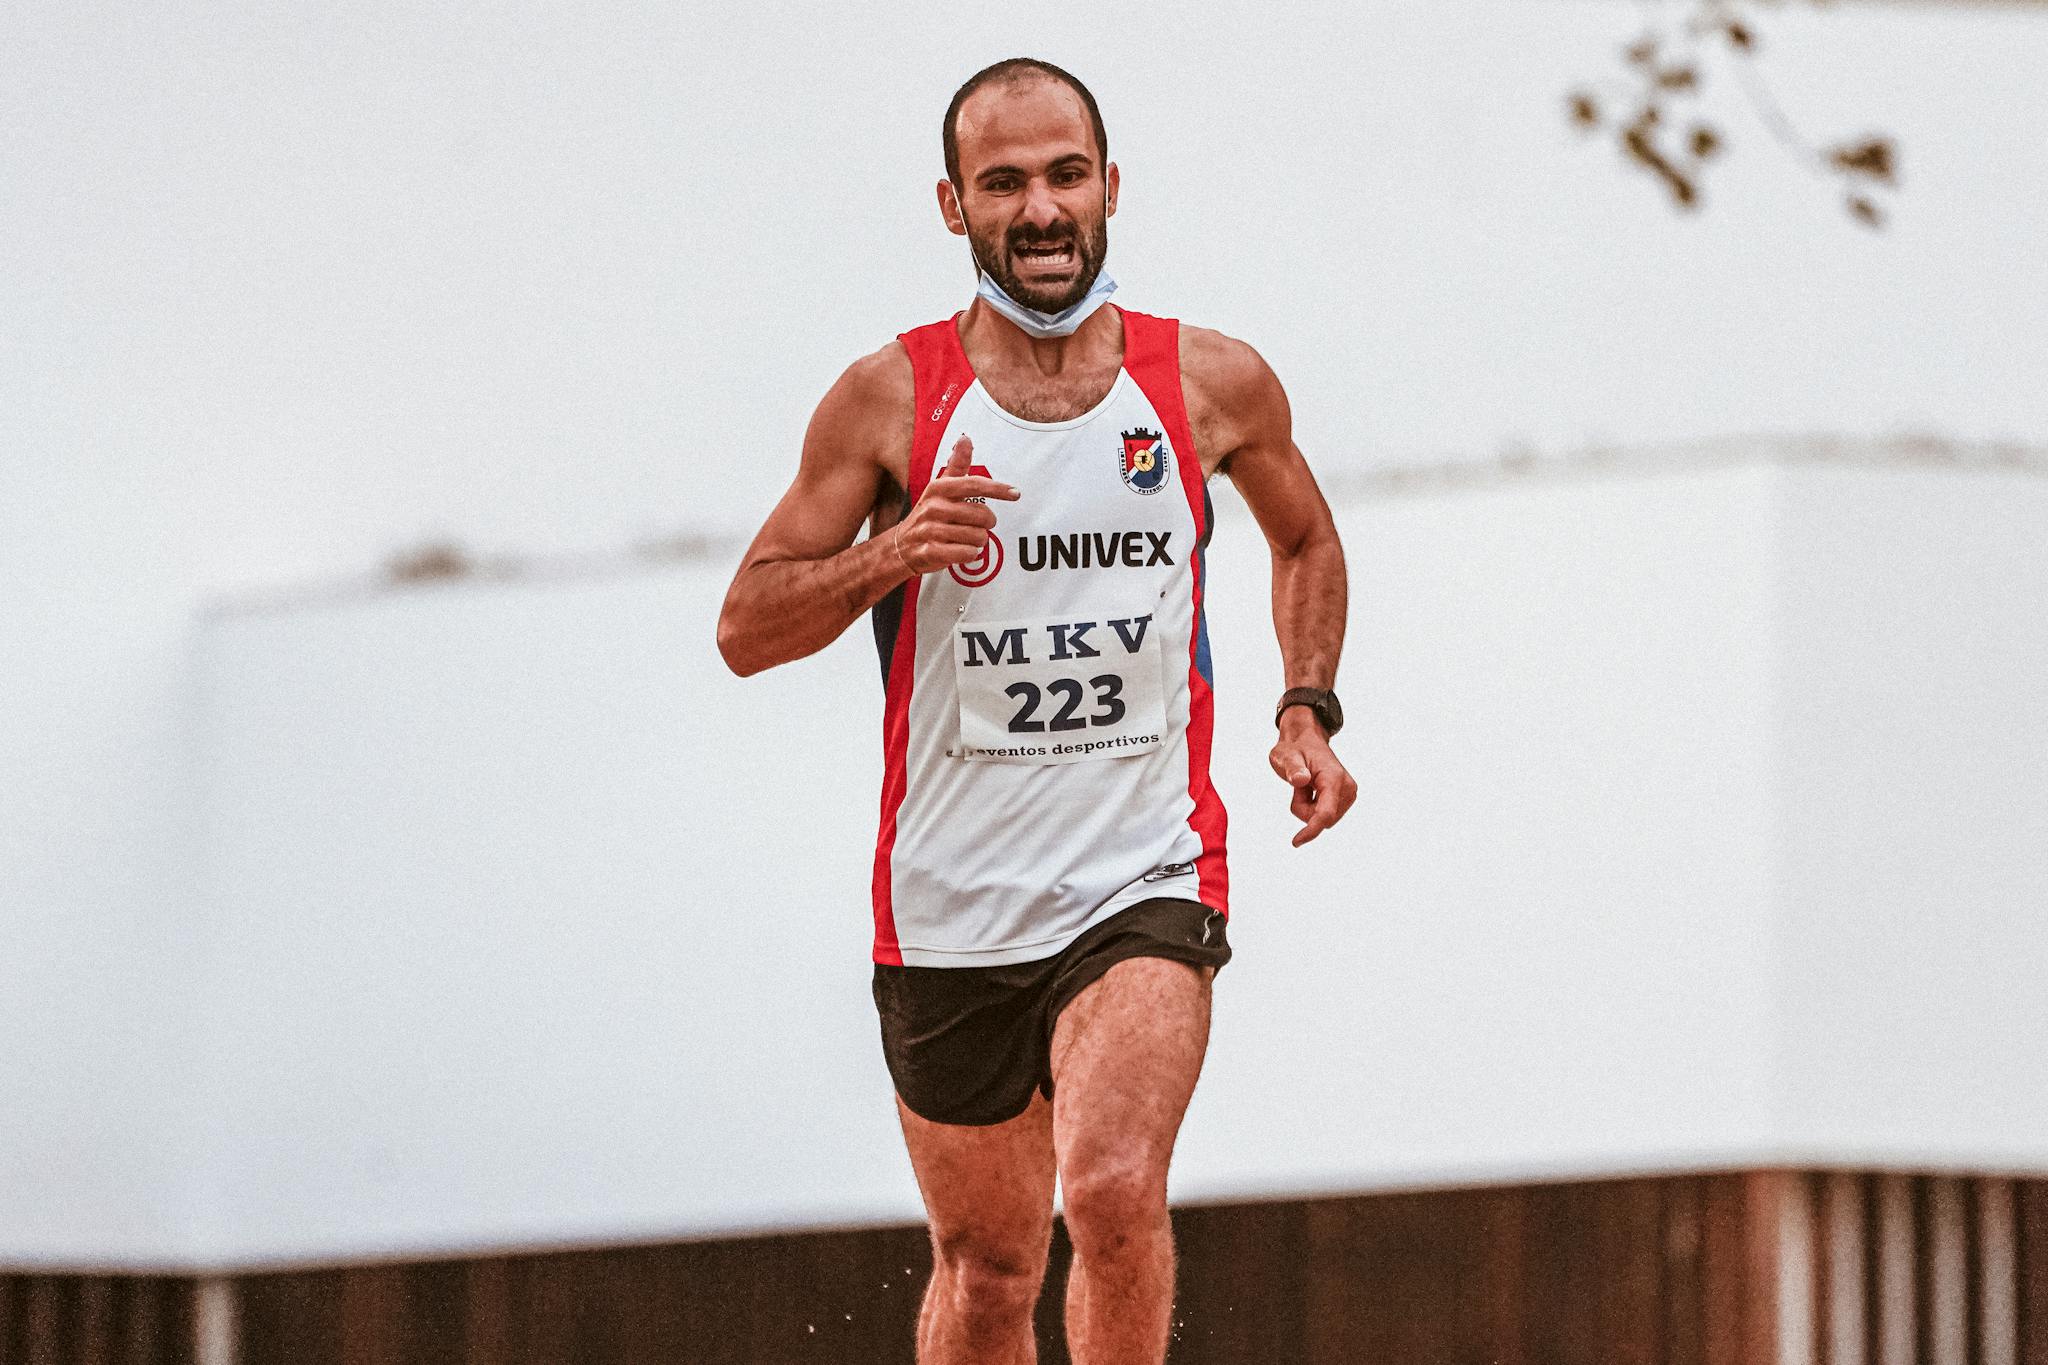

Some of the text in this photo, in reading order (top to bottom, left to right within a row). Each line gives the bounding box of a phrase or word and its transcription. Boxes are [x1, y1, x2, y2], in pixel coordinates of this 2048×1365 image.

[1019, 531, 1175, 571] UNIVEX
[1004, 674, 1126, 733] 223
[1052, 733, 1160, 754] desportivos
